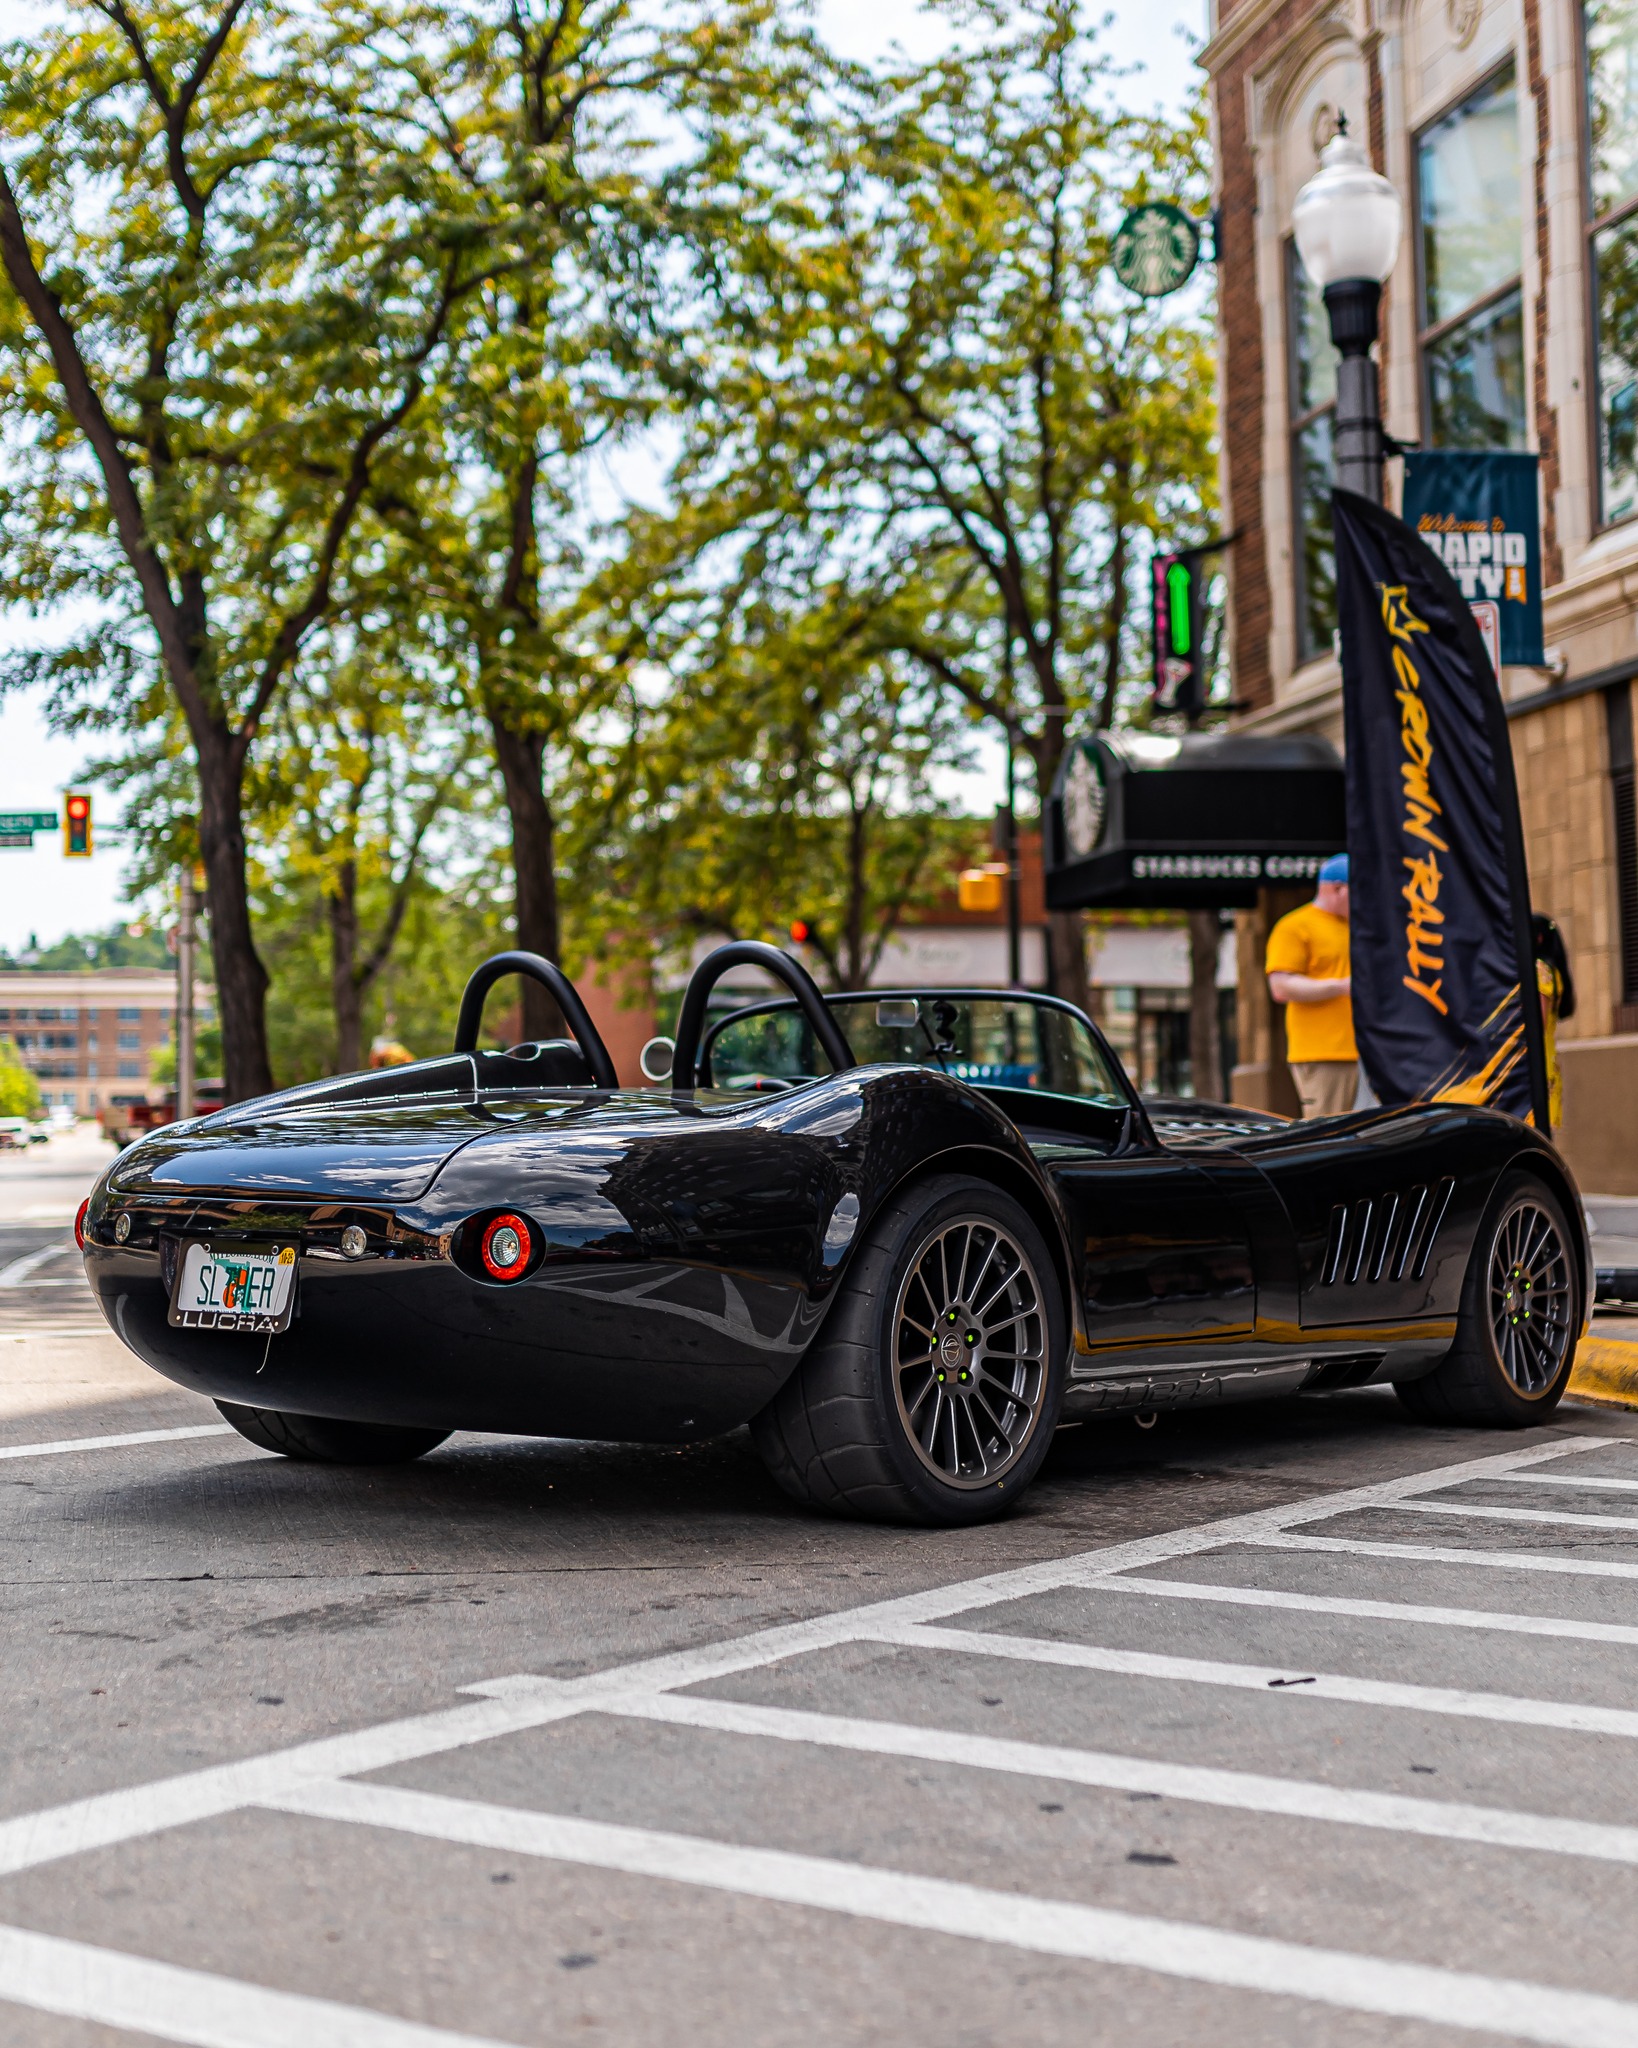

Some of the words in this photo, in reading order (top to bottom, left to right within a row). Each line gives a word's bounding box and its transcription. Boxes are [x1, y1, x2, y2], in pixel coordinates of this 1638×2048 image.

[1417, 513, 1488, 532] Welcome
[1491, 516, 1505, 532] to
[1449, 566, 1504, 598] TY
[1391, 644, 1450, 852] CROWN
[1133, 856, 1261, 878] STARBUCKS
[1265, 856, 1328, 878] COFF
[1402, 850, 1449, 1015] RALLY
[182, 1311, 275, 1332] LUCRA
